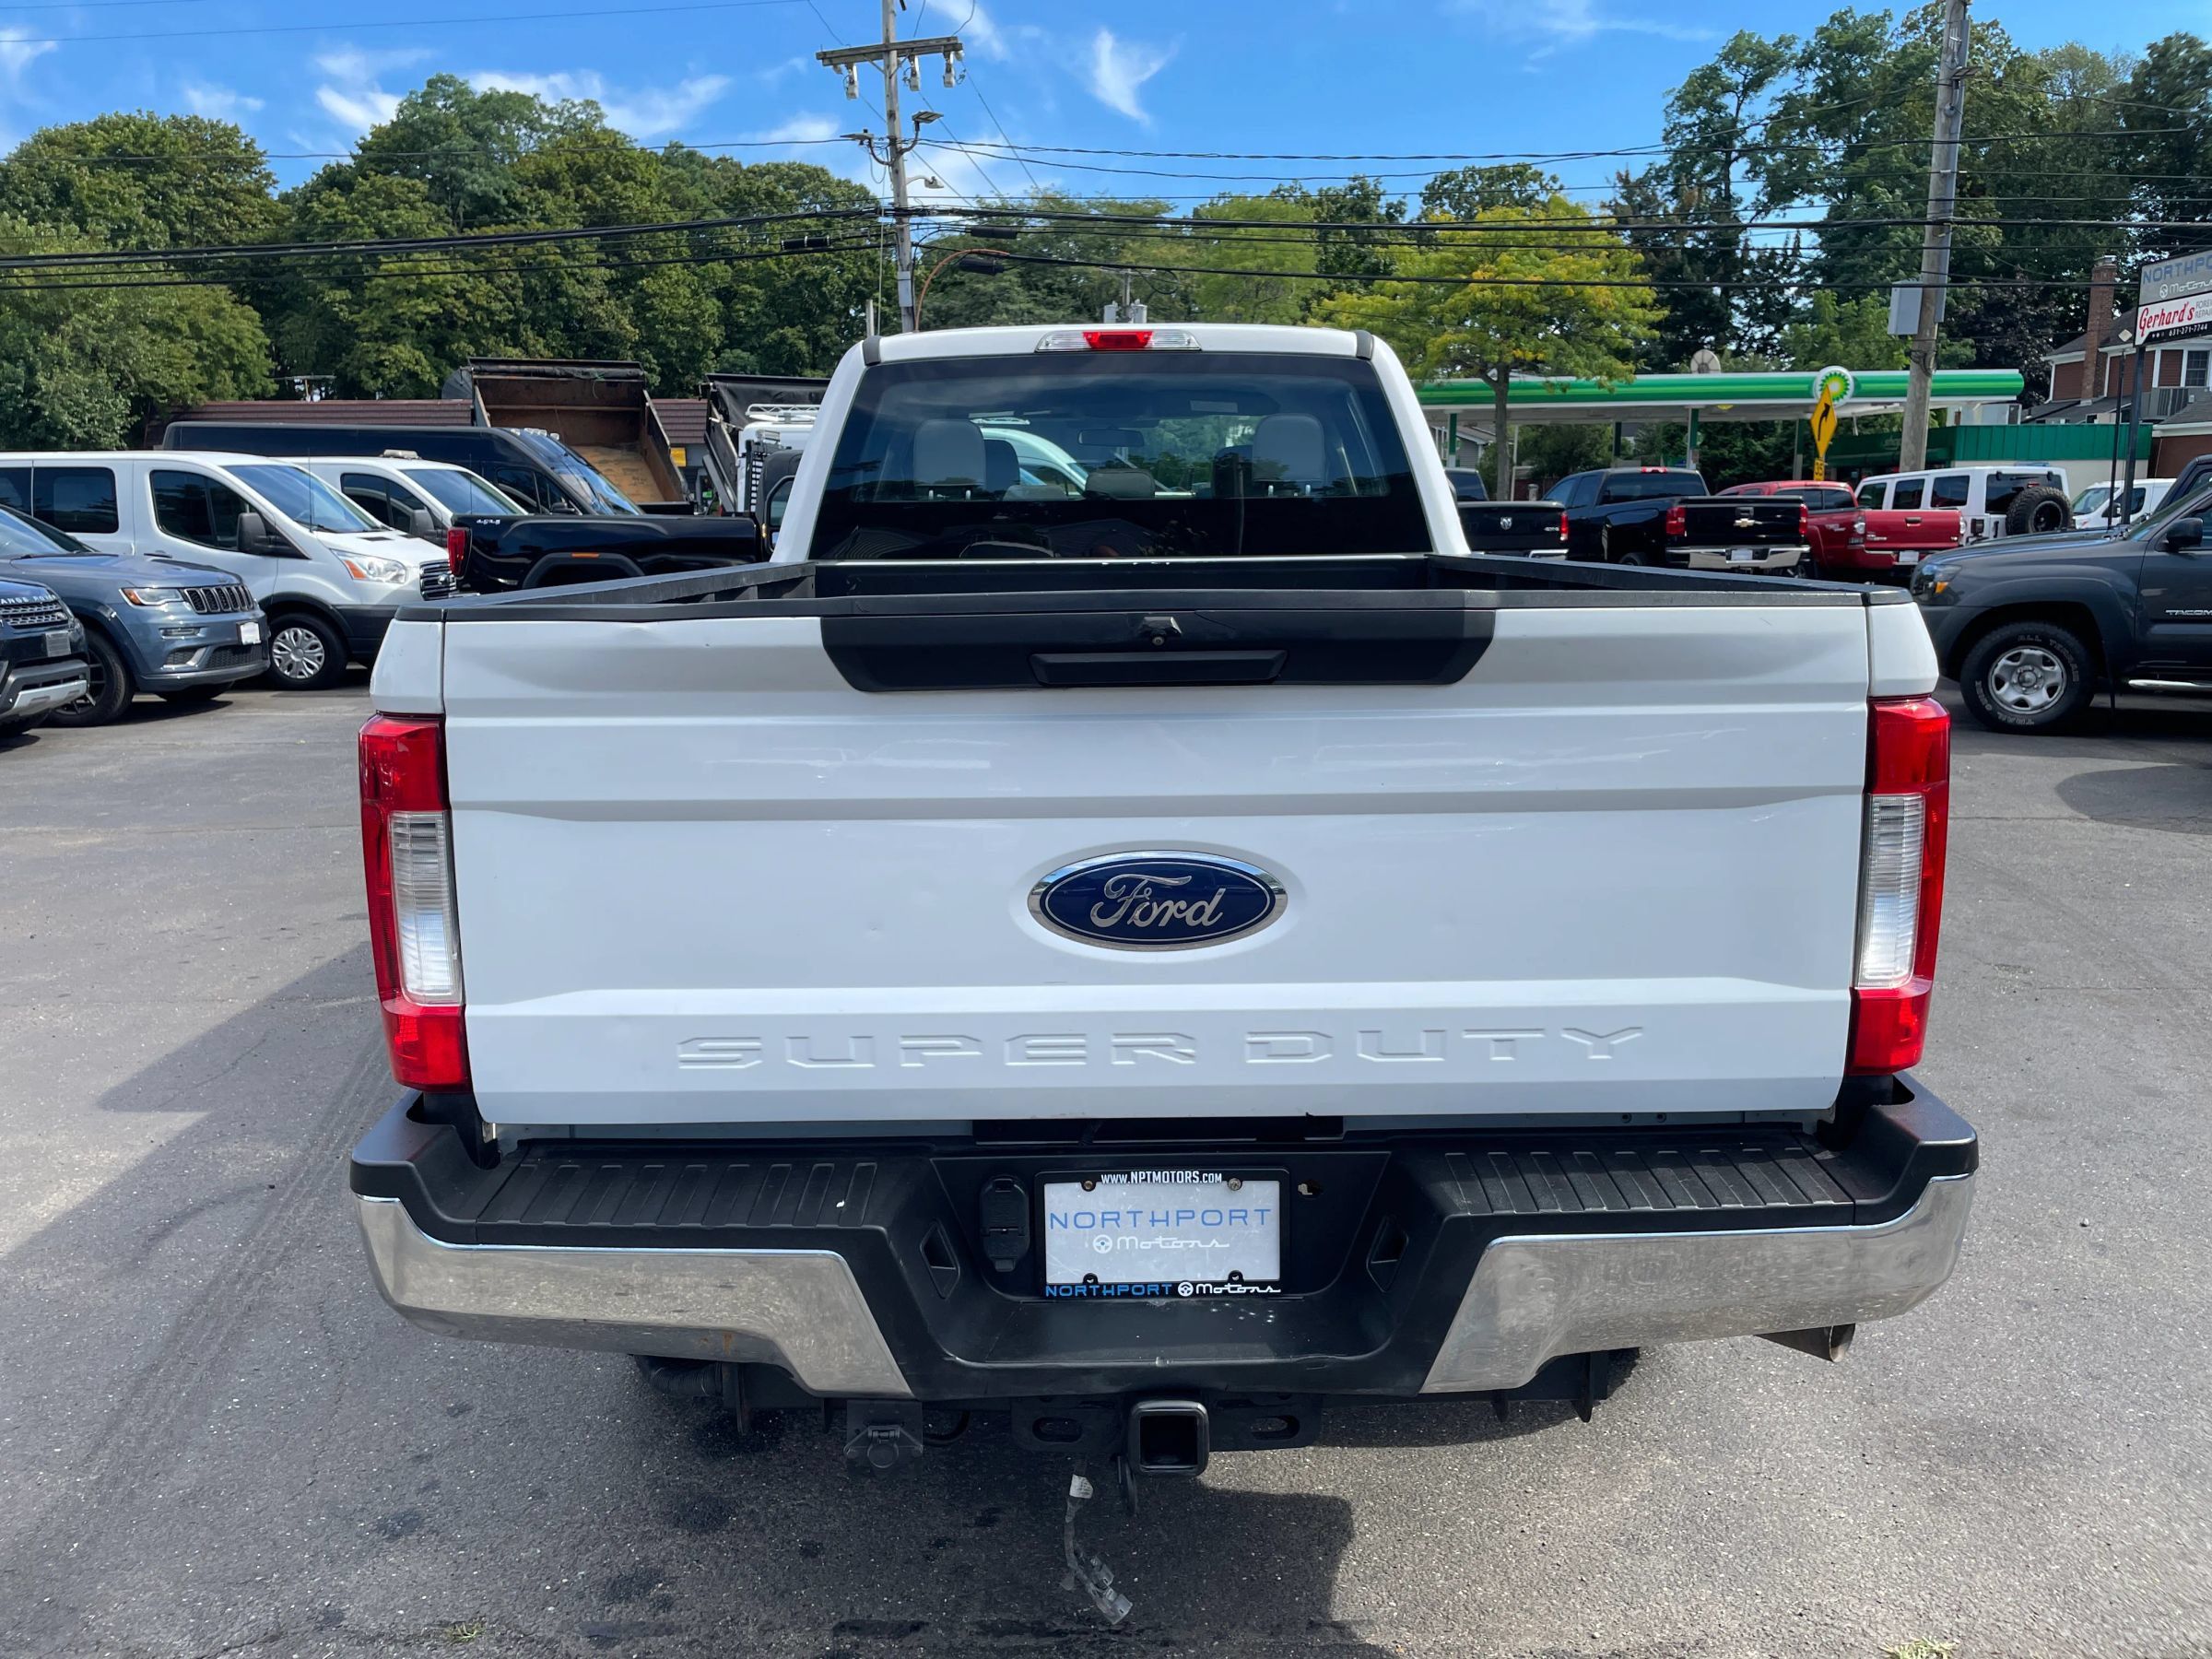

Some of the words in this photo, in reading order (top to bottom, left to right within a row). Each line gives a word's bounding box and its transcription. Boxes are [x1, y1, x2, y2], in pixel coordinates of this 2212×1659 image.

[2139, 301, 2194, 337] Gerhard's
[2169, 324, 2208, 336] 631-271-7744
[1089, 874, 1226, 927] Ford
[677, 1033, 1196, 1069] SUPER
[1245, 1027, 1643, 1064] DUTY
[1050, 1208, 1272, 1230] NORTHPORT
[1116, 1235, 1230, 1250] Motors
[1045, 1283, 1172, 1297] NORTHPORT
[1195, 1282, 1282, 1295] Motors
